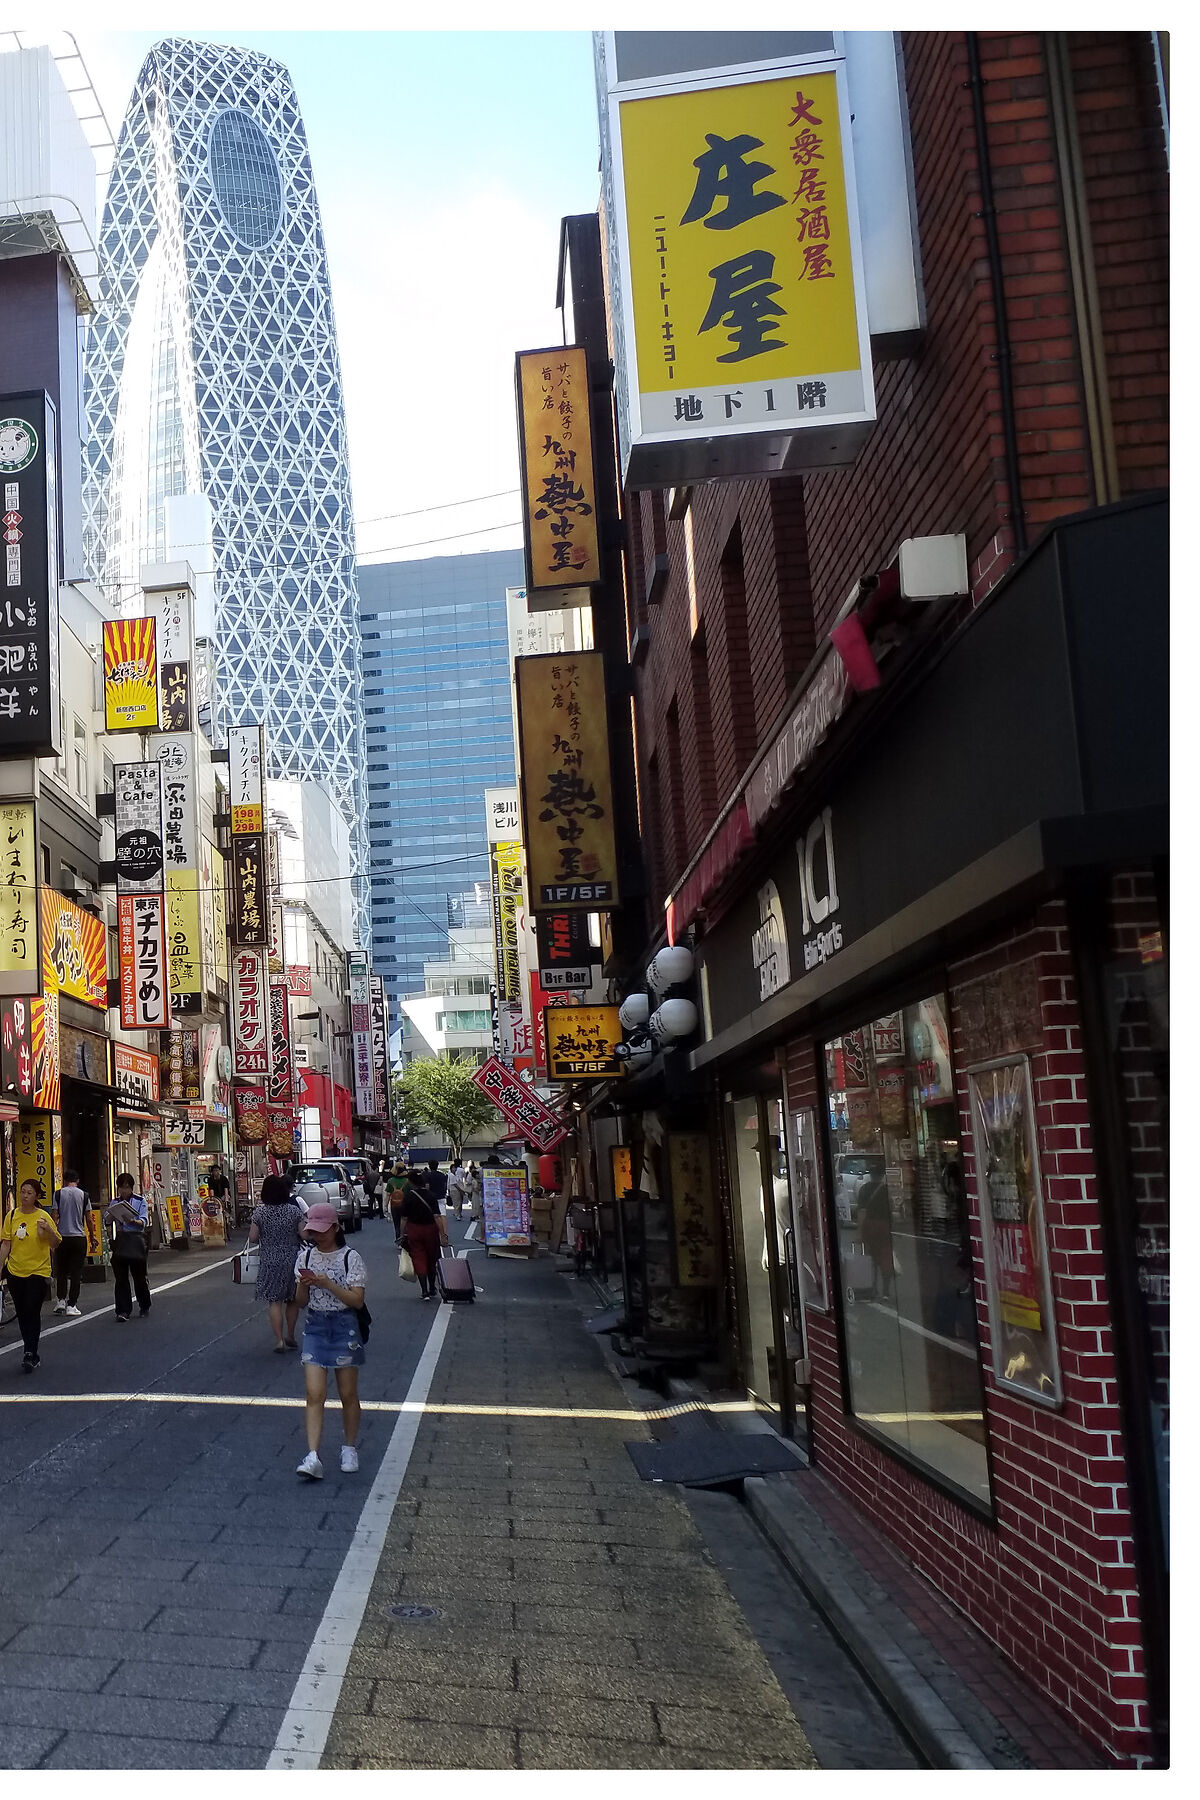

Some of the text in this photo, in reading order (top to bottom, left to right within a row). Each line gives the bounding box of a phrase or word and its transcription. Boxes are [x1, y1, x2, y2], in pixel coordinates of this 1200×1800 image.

[788, 91, 835, 281] 大衆居酒屋
[679, 132, 789, 365] 庄屋
[674, 381, 827, 421] 地下1階
[119, 769, 156, 780] Pasta
[134, 781, 142, 790] &
[122, 790, 154, 801] Cafe
[130, 836, 147, 846] 元祖
[116, 845, 162, 861] 壁の穴
[240, 857, 261, 929] 山内農場
[545, 884, 607, 902] 1F/5F
[135, 897, 160, 911] 東京
[245, 932, 259, 942] 4F
[136, 911, 161, 1023] チカラめし
[566, 971, 587, 984] Bar
[238, 954, 263, 1042] カラオケ
[237, 1054, 267, 1070] 24h
[569, 1061, 607, 1073] 1F/5F
[165, 1119, 204, 1133] チカラ
[182, 1132, 204, 1145] めし
